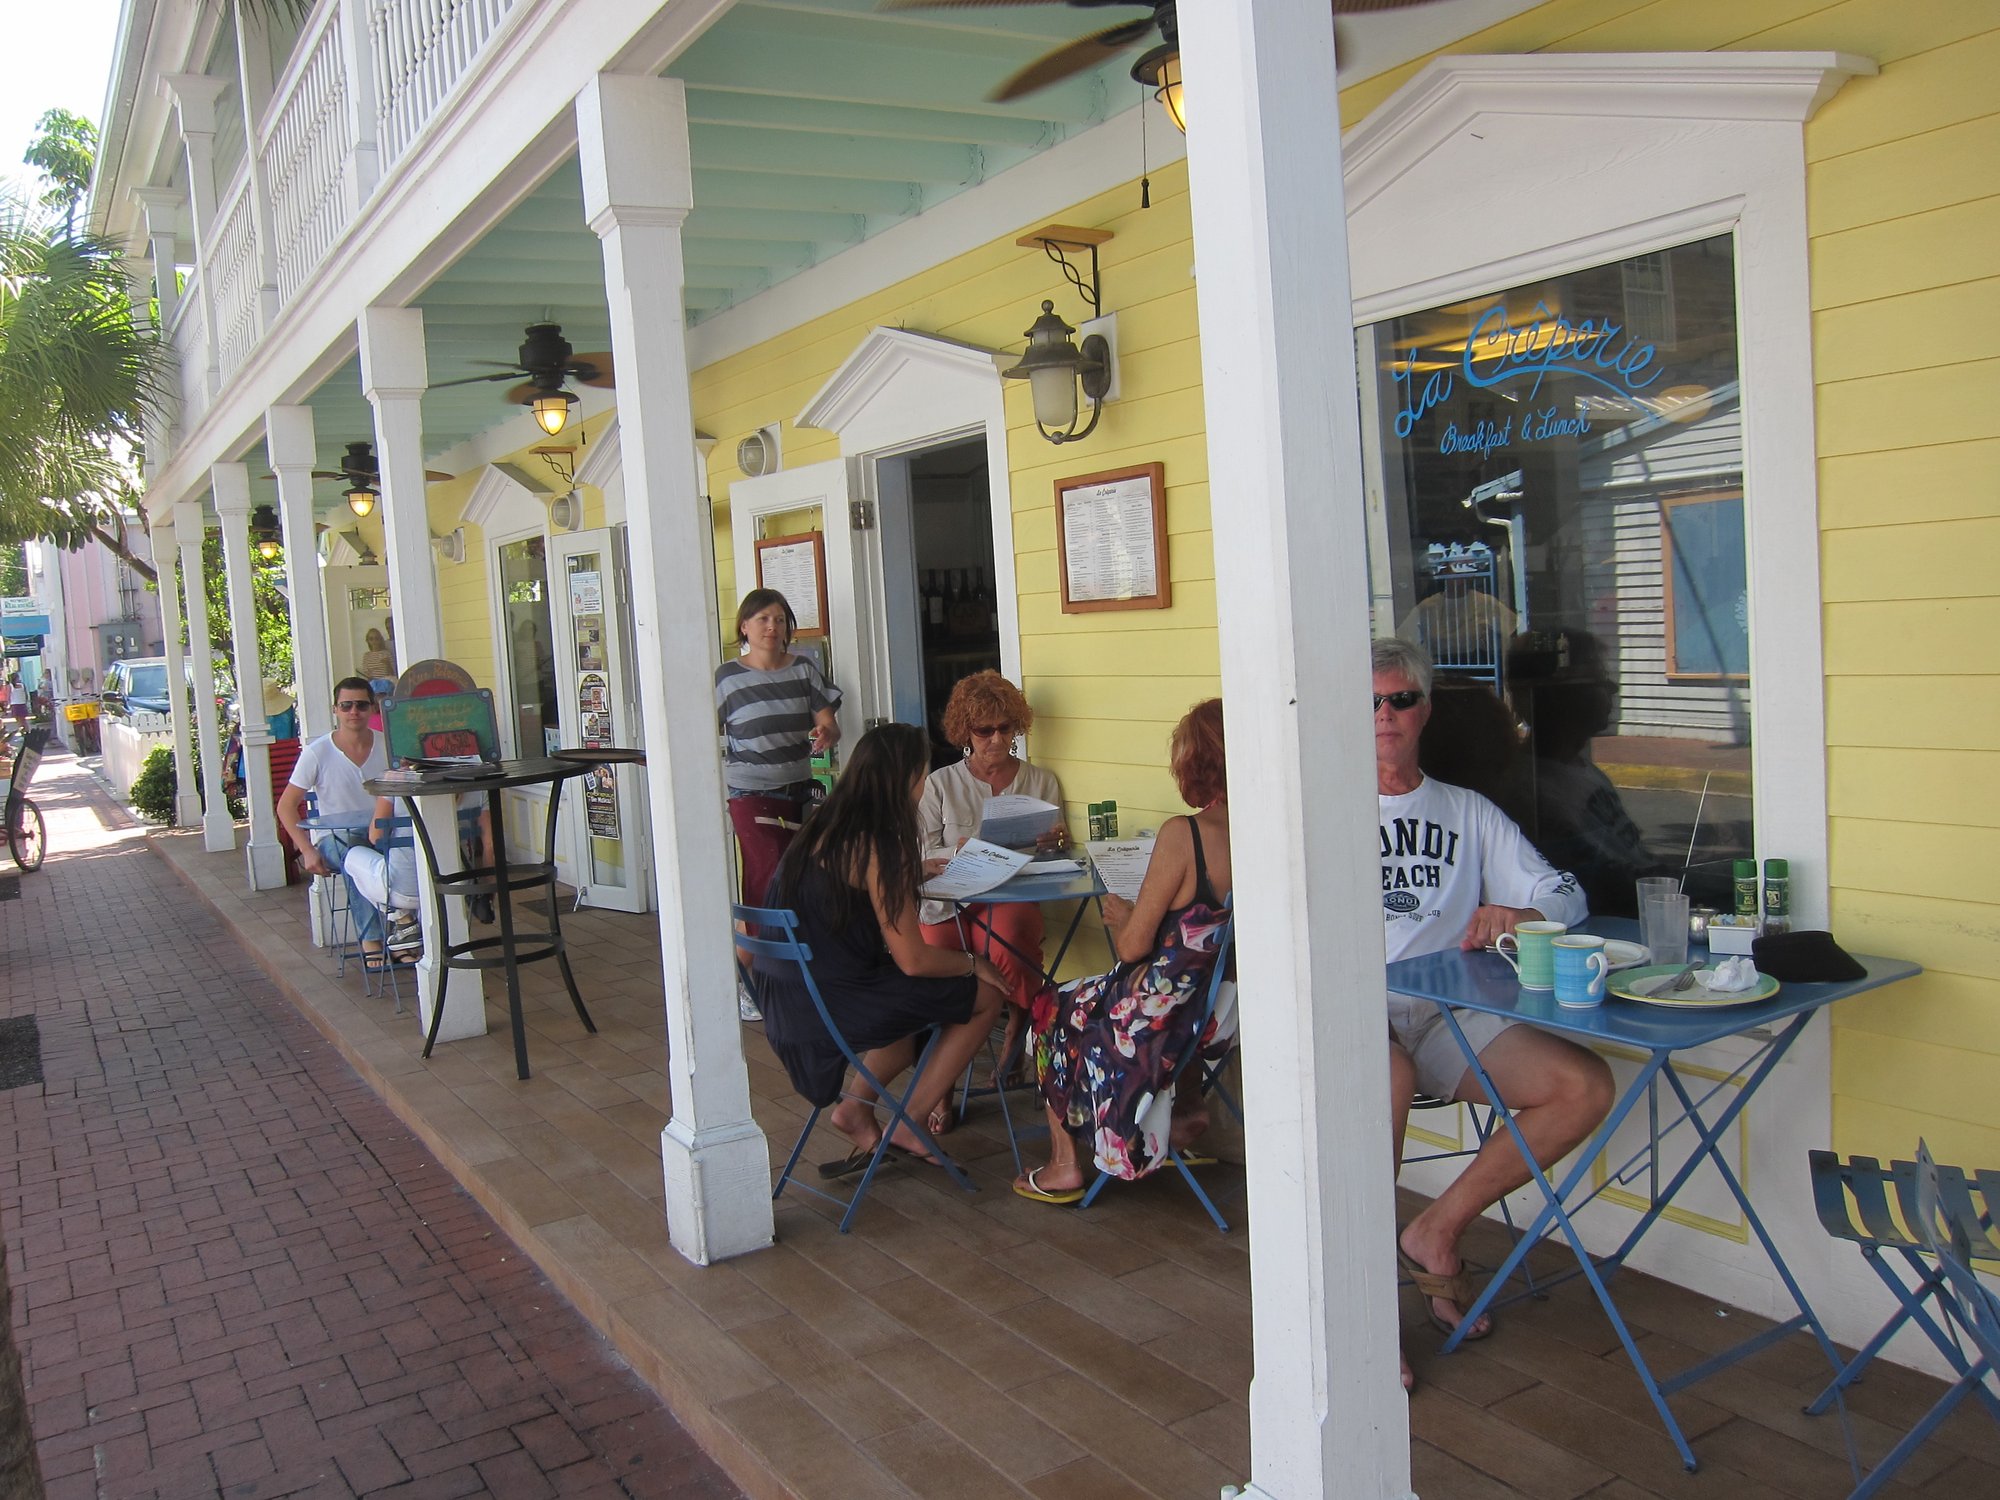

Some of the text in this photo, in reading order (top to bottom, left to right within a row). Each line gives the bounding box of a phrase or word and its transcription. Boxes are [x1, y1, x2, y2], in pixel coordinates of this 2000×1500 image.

[1392, 300, 1665, 438] La Crêperie
[1440, 401, 1592, 460] Breakfast & Lunch
